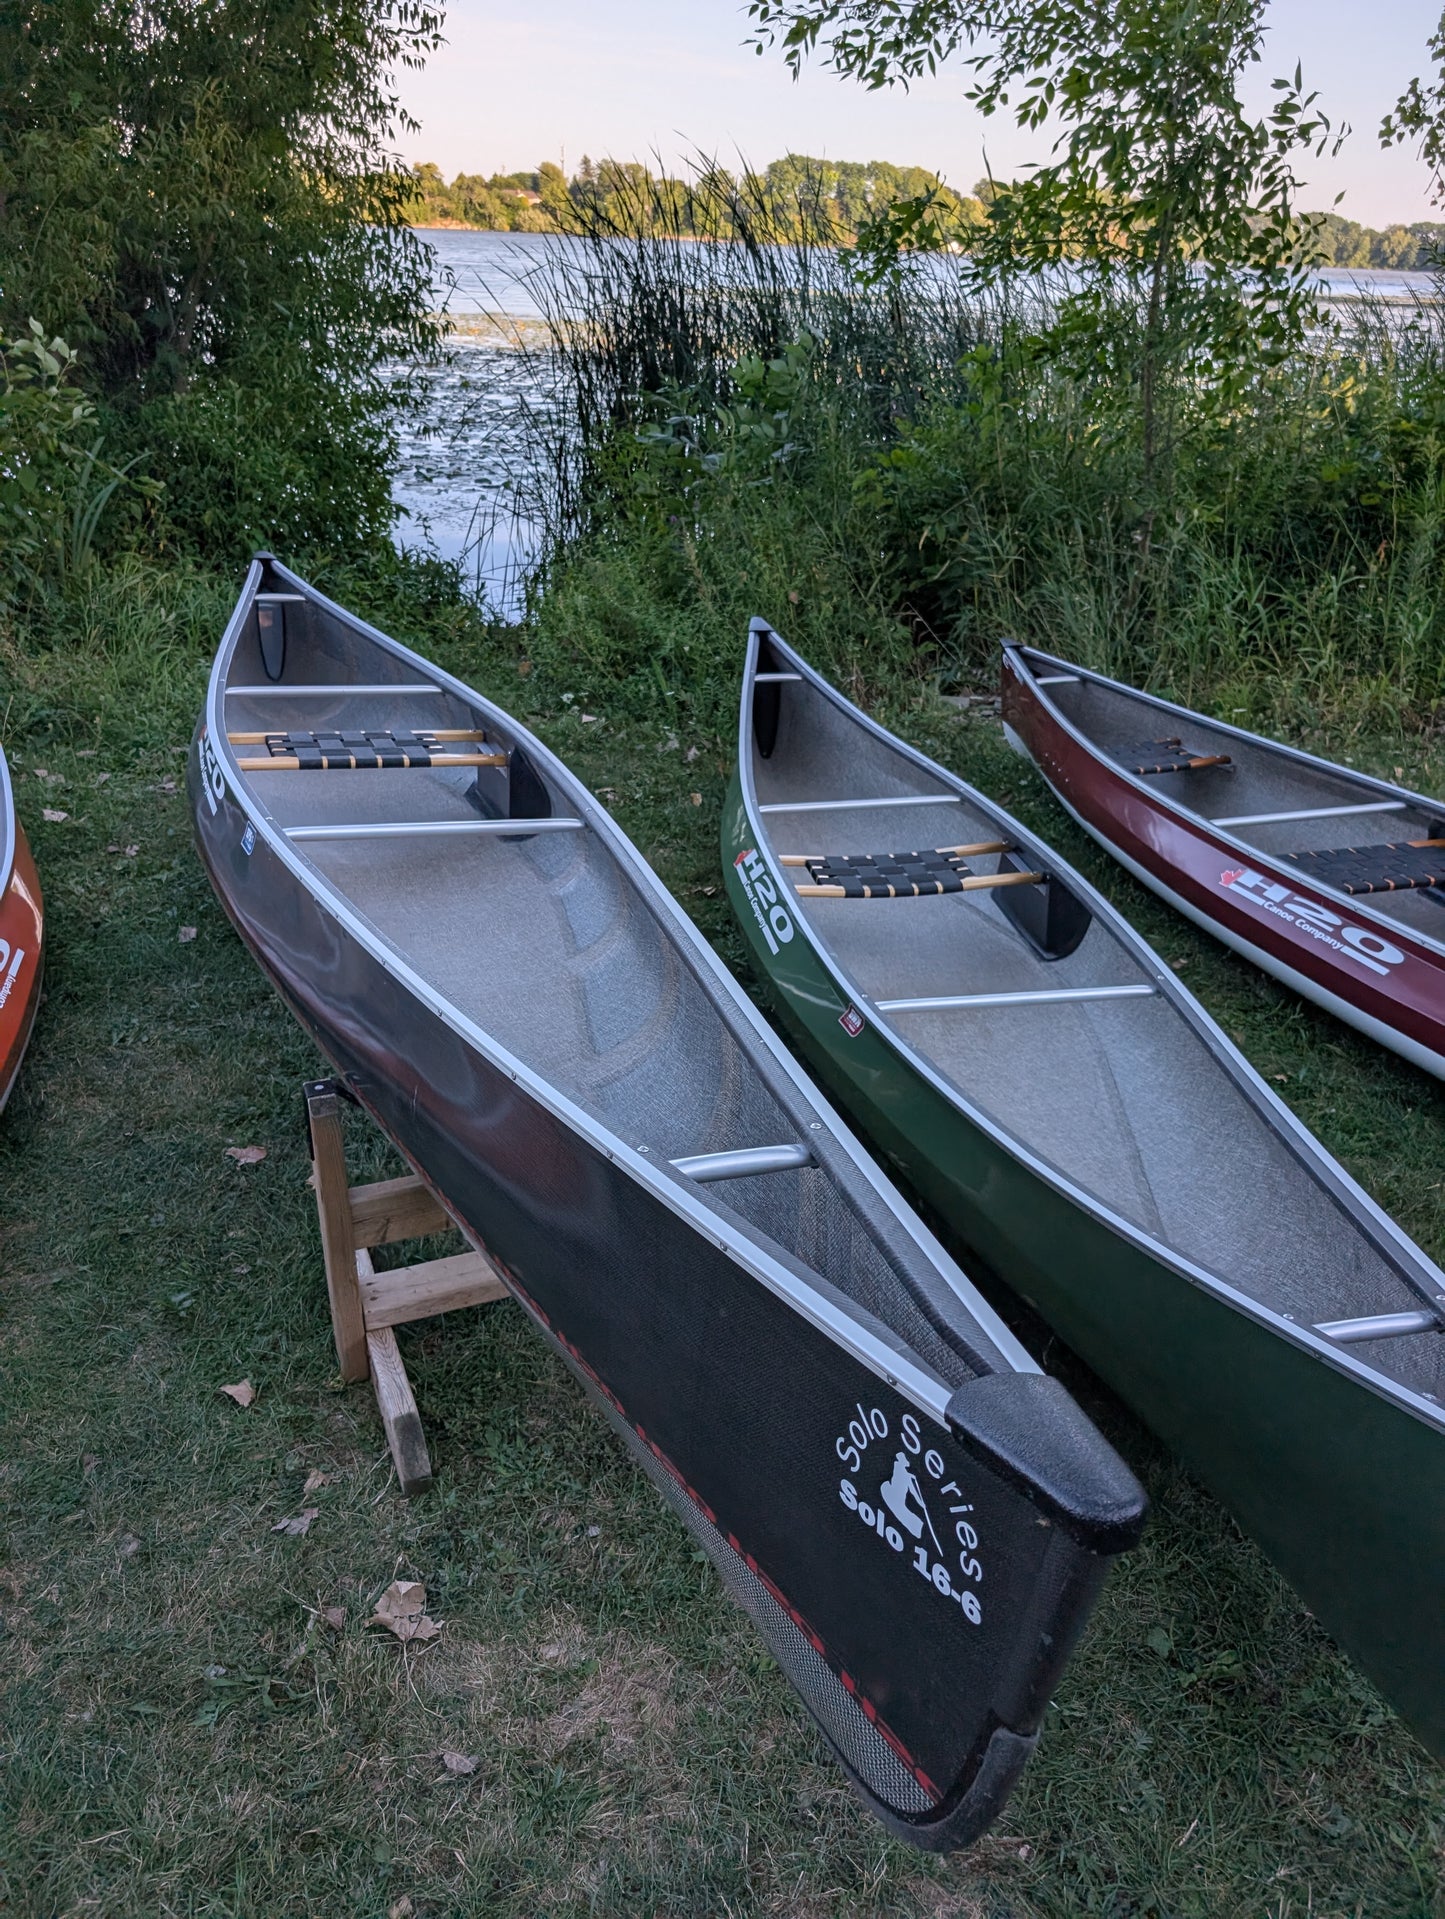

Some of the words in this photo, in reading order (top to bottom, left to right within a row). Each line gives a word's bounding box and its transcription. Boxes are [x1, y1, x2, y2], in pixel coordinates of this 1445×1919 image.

[744, 849, 794, 943] H2O
[751, 897, 766, 928] Company
[1236, 869, 1405, 964] H2O
[1263, 900, 1295, 922] Canoe
[1295, 918, 1344, 951] Company
[836, 1403, 888, 1472] Solo
[900, 1414, 982, 1581] Series
[839, 1479, 904, 1552] Solo
[913, 1546, 981, 1624] 16-6
